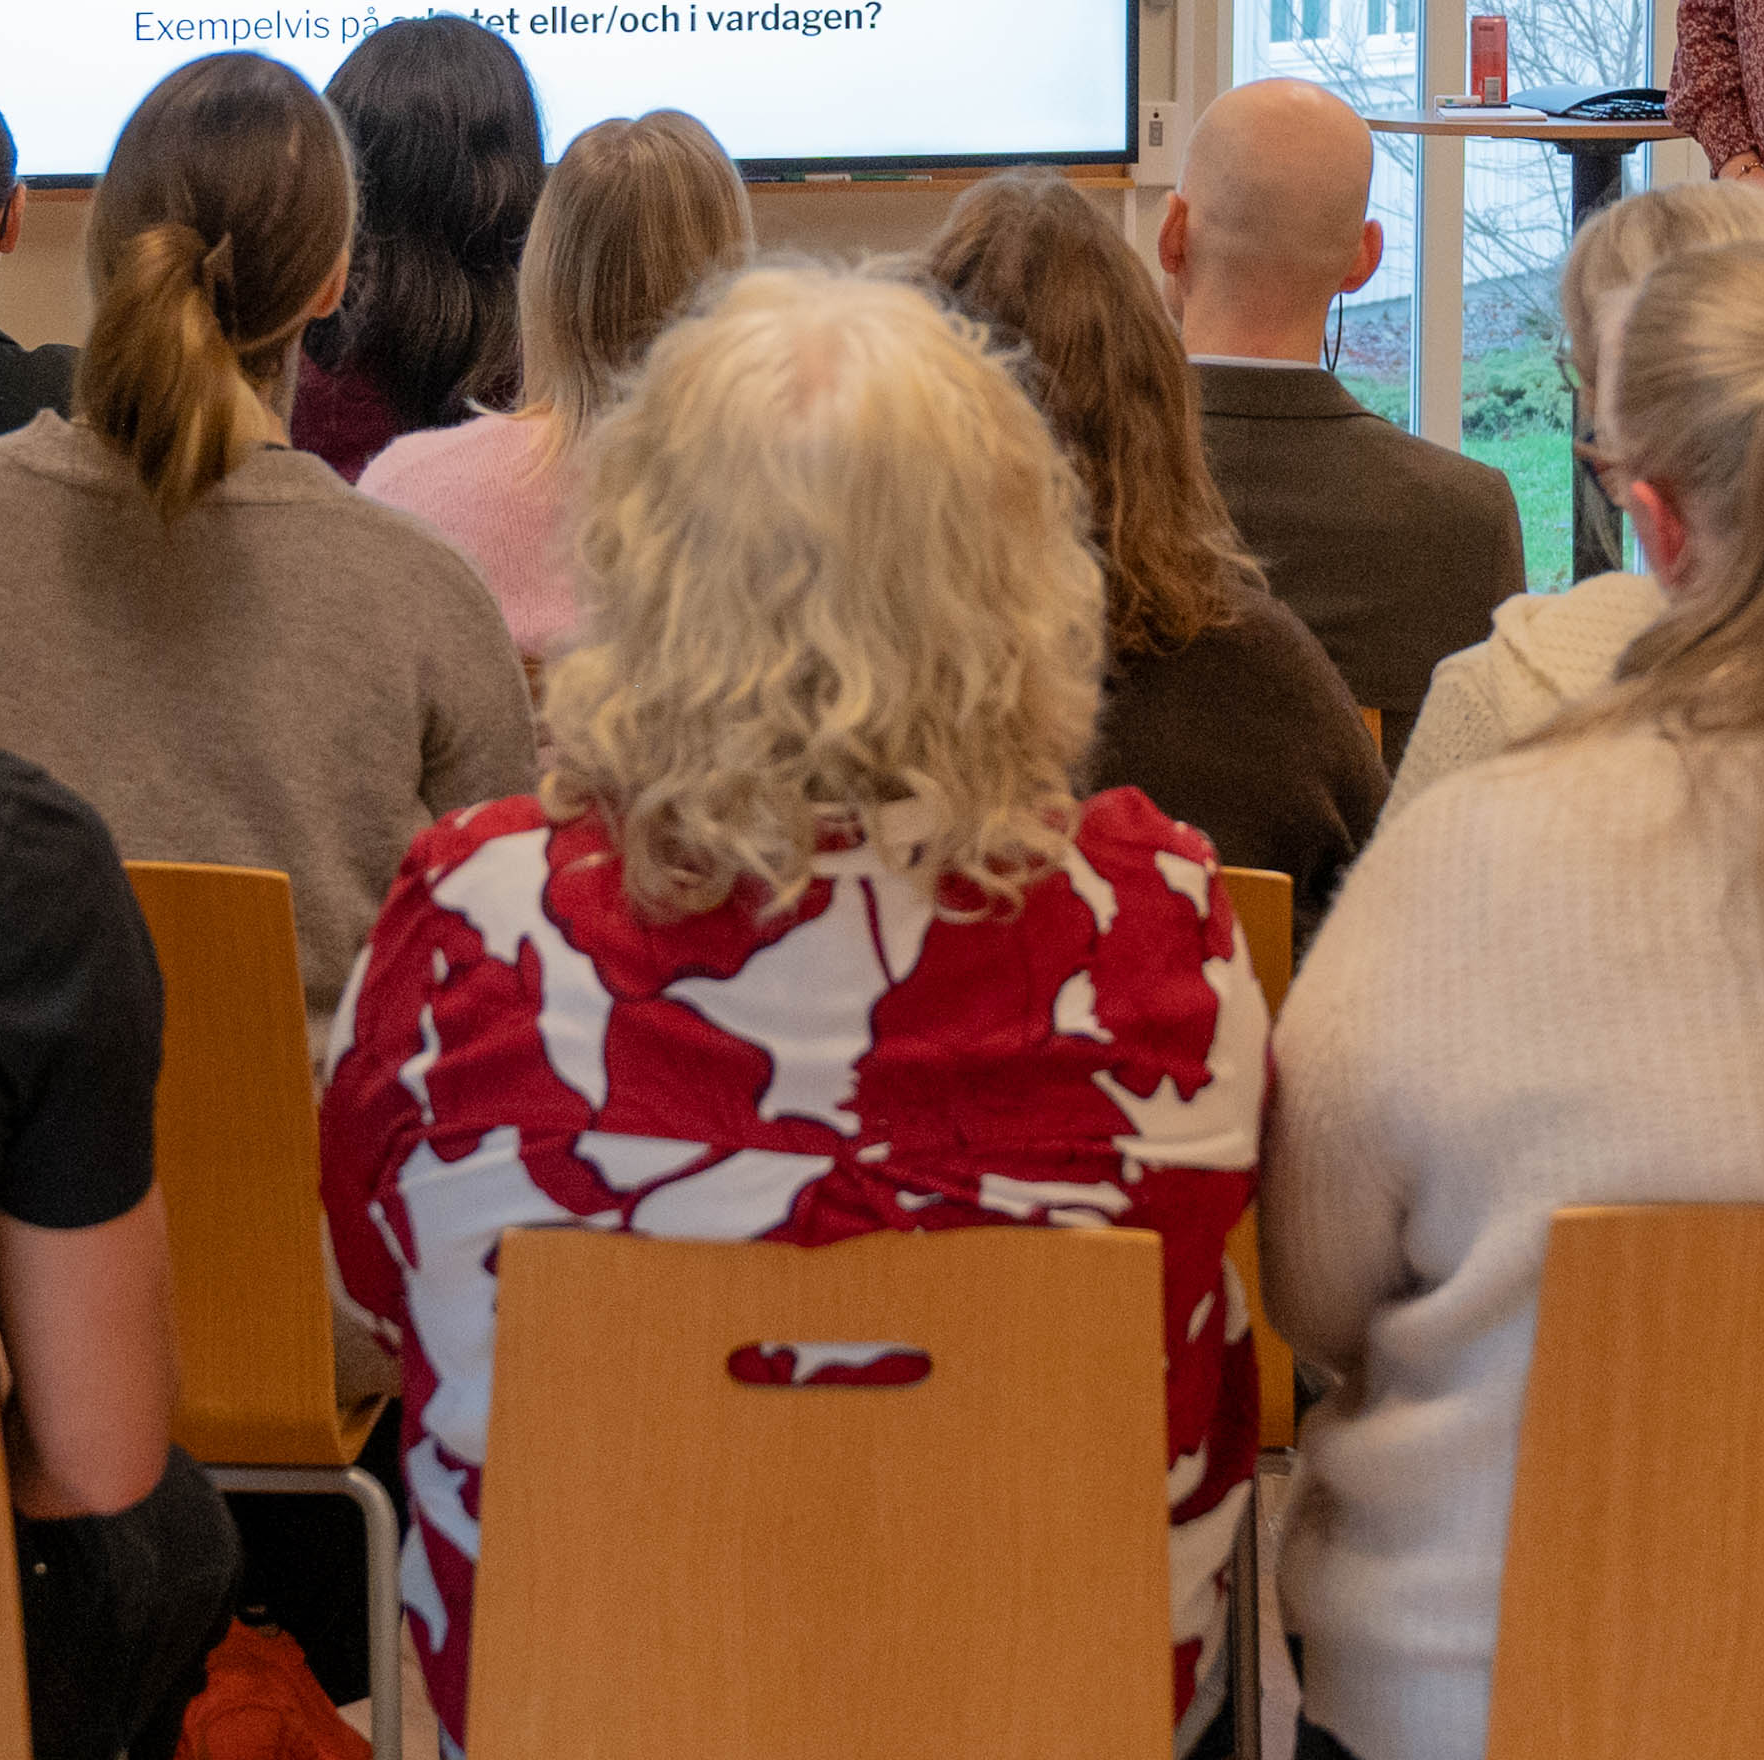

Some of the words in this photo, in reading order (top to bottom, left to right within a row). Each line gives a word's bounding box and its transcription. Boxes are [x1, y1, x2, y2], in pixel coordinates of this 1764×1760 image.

[136, 10, 330, 44] Exempelvis
[342, 6, 379, 44] på
[529, 4, 680, 34] eller/och
[690, 4, 697, 32] i
[707, 1, 883, 37] vardagen?
